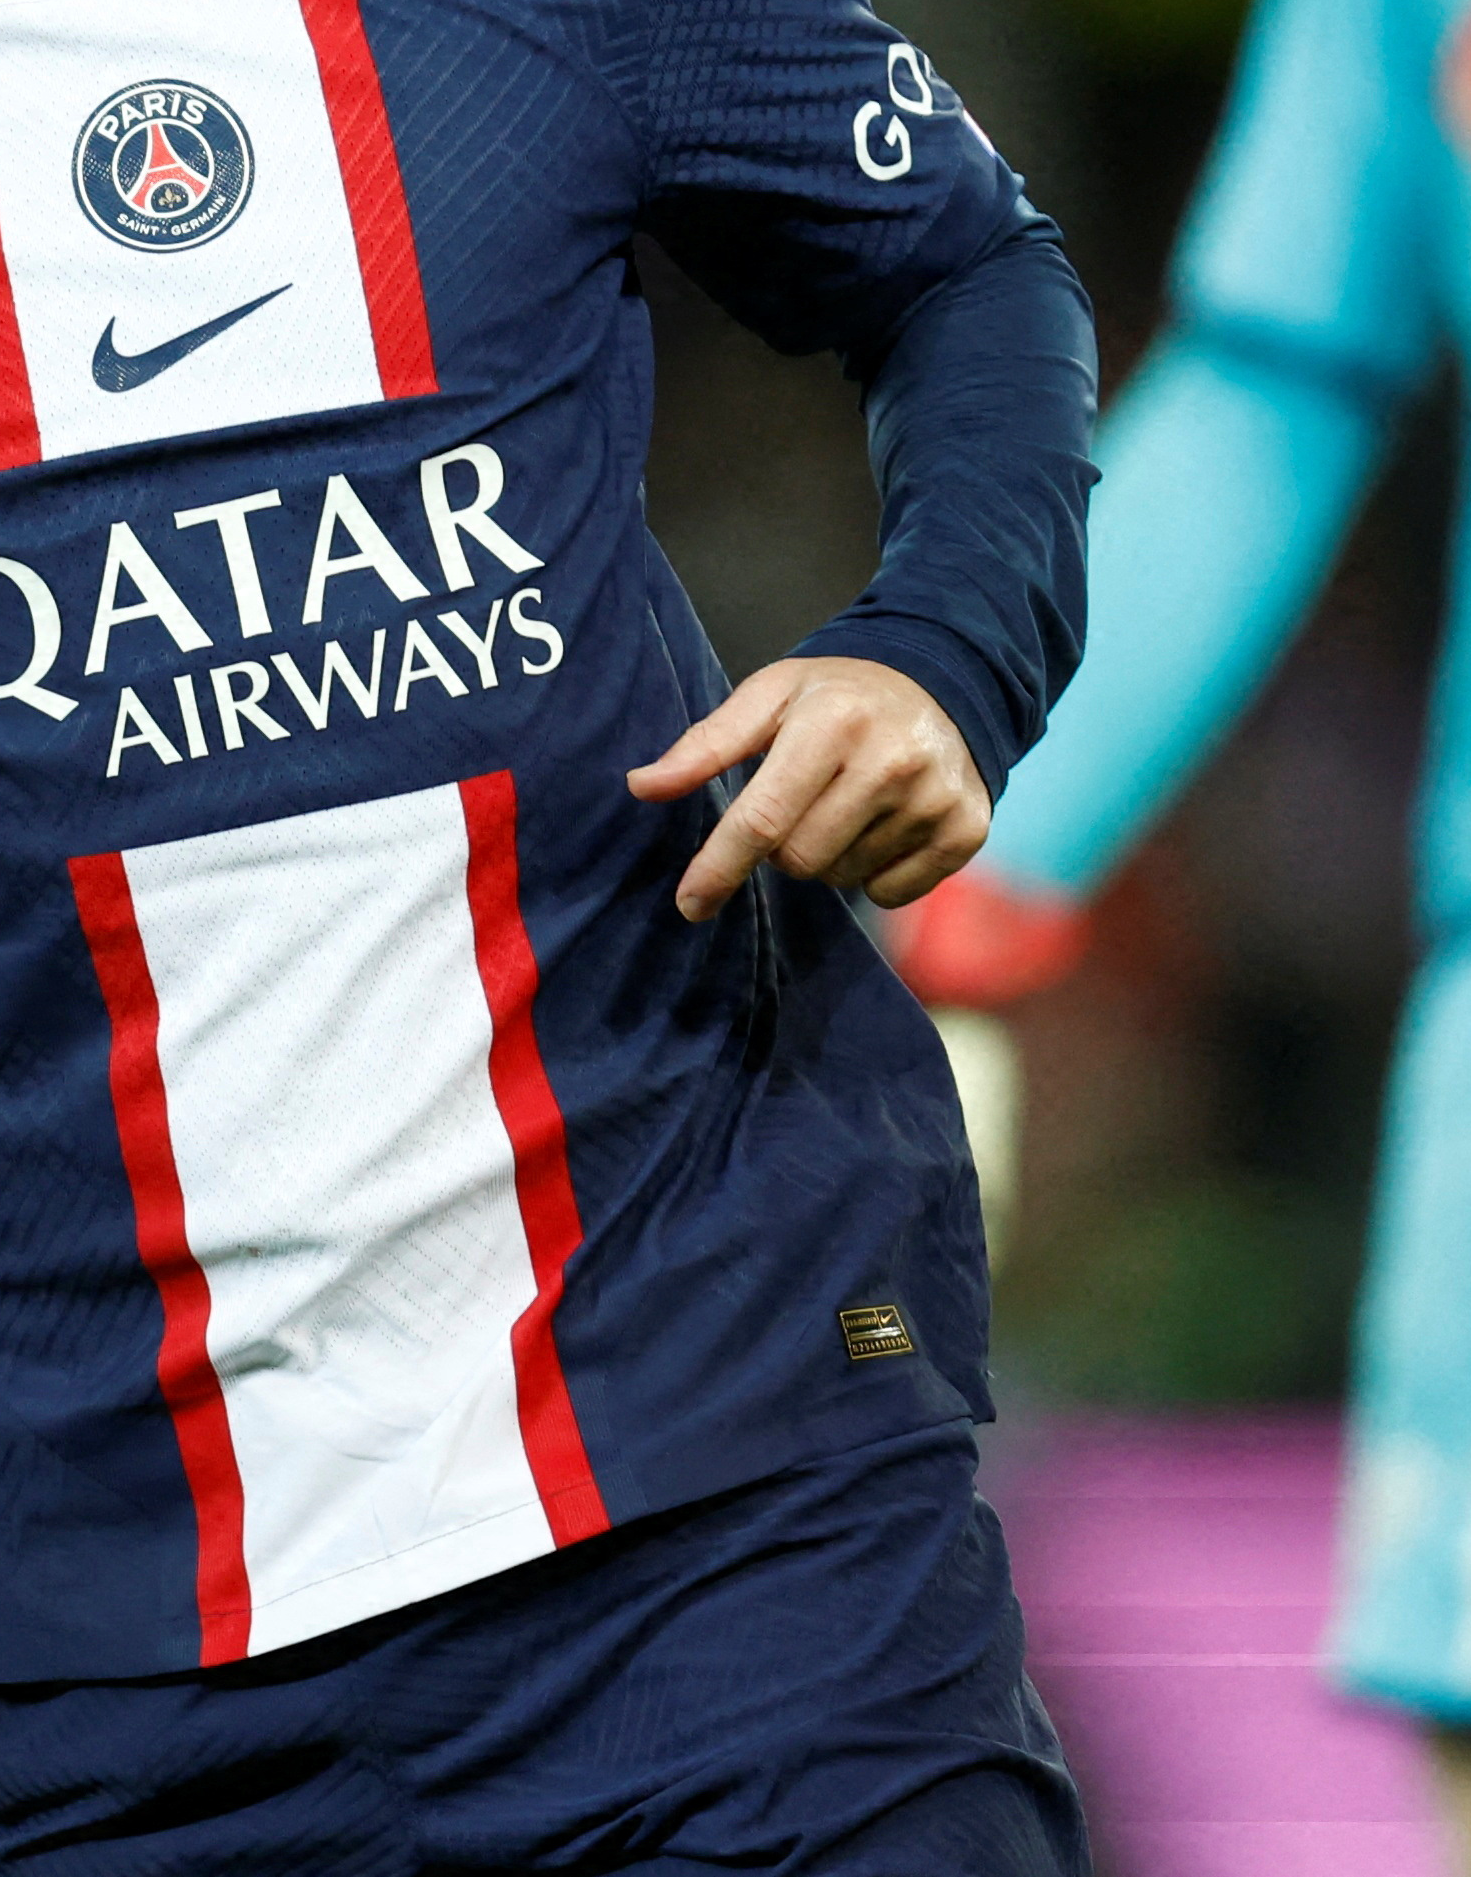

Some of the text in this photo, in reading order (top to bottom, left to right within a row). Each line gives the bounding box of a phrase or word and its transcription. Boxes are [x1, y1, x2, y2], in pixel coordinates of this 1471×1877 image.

[97, 92, 208, 143] PARIS
[117, 194, 227, 237] SAINT GERMAIN
[106, 587, 564, 778] AIRWAYS
